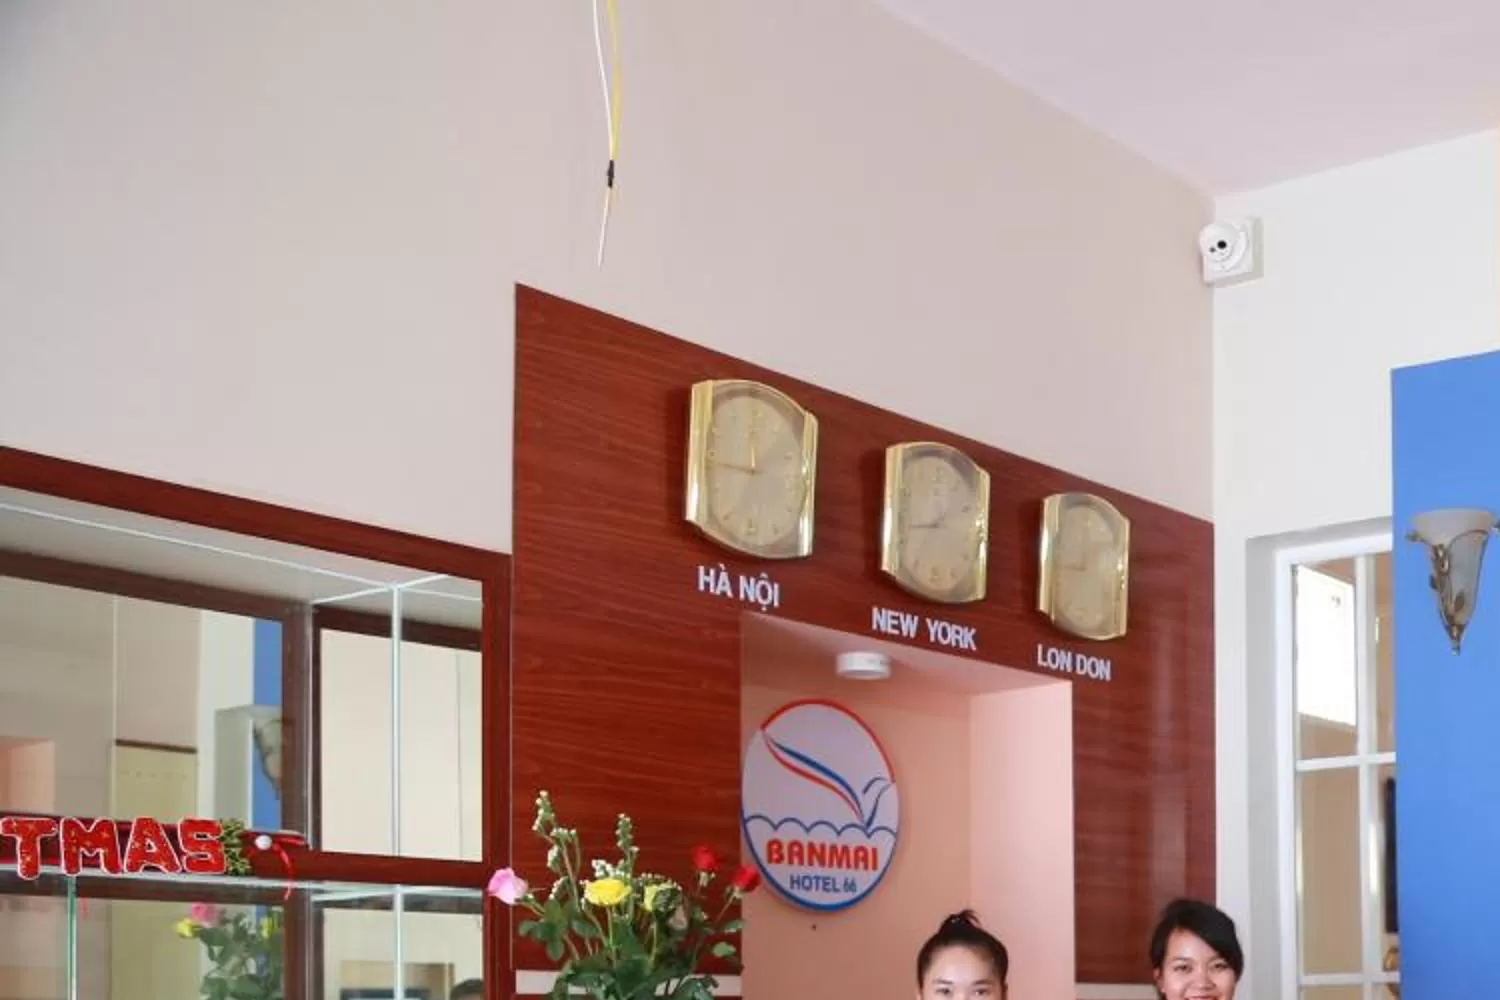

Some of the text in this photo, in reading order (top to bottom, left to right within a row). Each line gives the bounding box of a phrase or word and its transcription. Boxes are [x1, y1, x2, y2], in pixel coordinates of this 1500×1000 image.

[698, 562, 779, 612] HÀ NỘI
[872, 606, 977, 651] NEW YORK
[0, 816, 227, 881] TMAS
[767, 838, 878, 871] BANMAI
[789, 874, 840, 893] HOTEL
